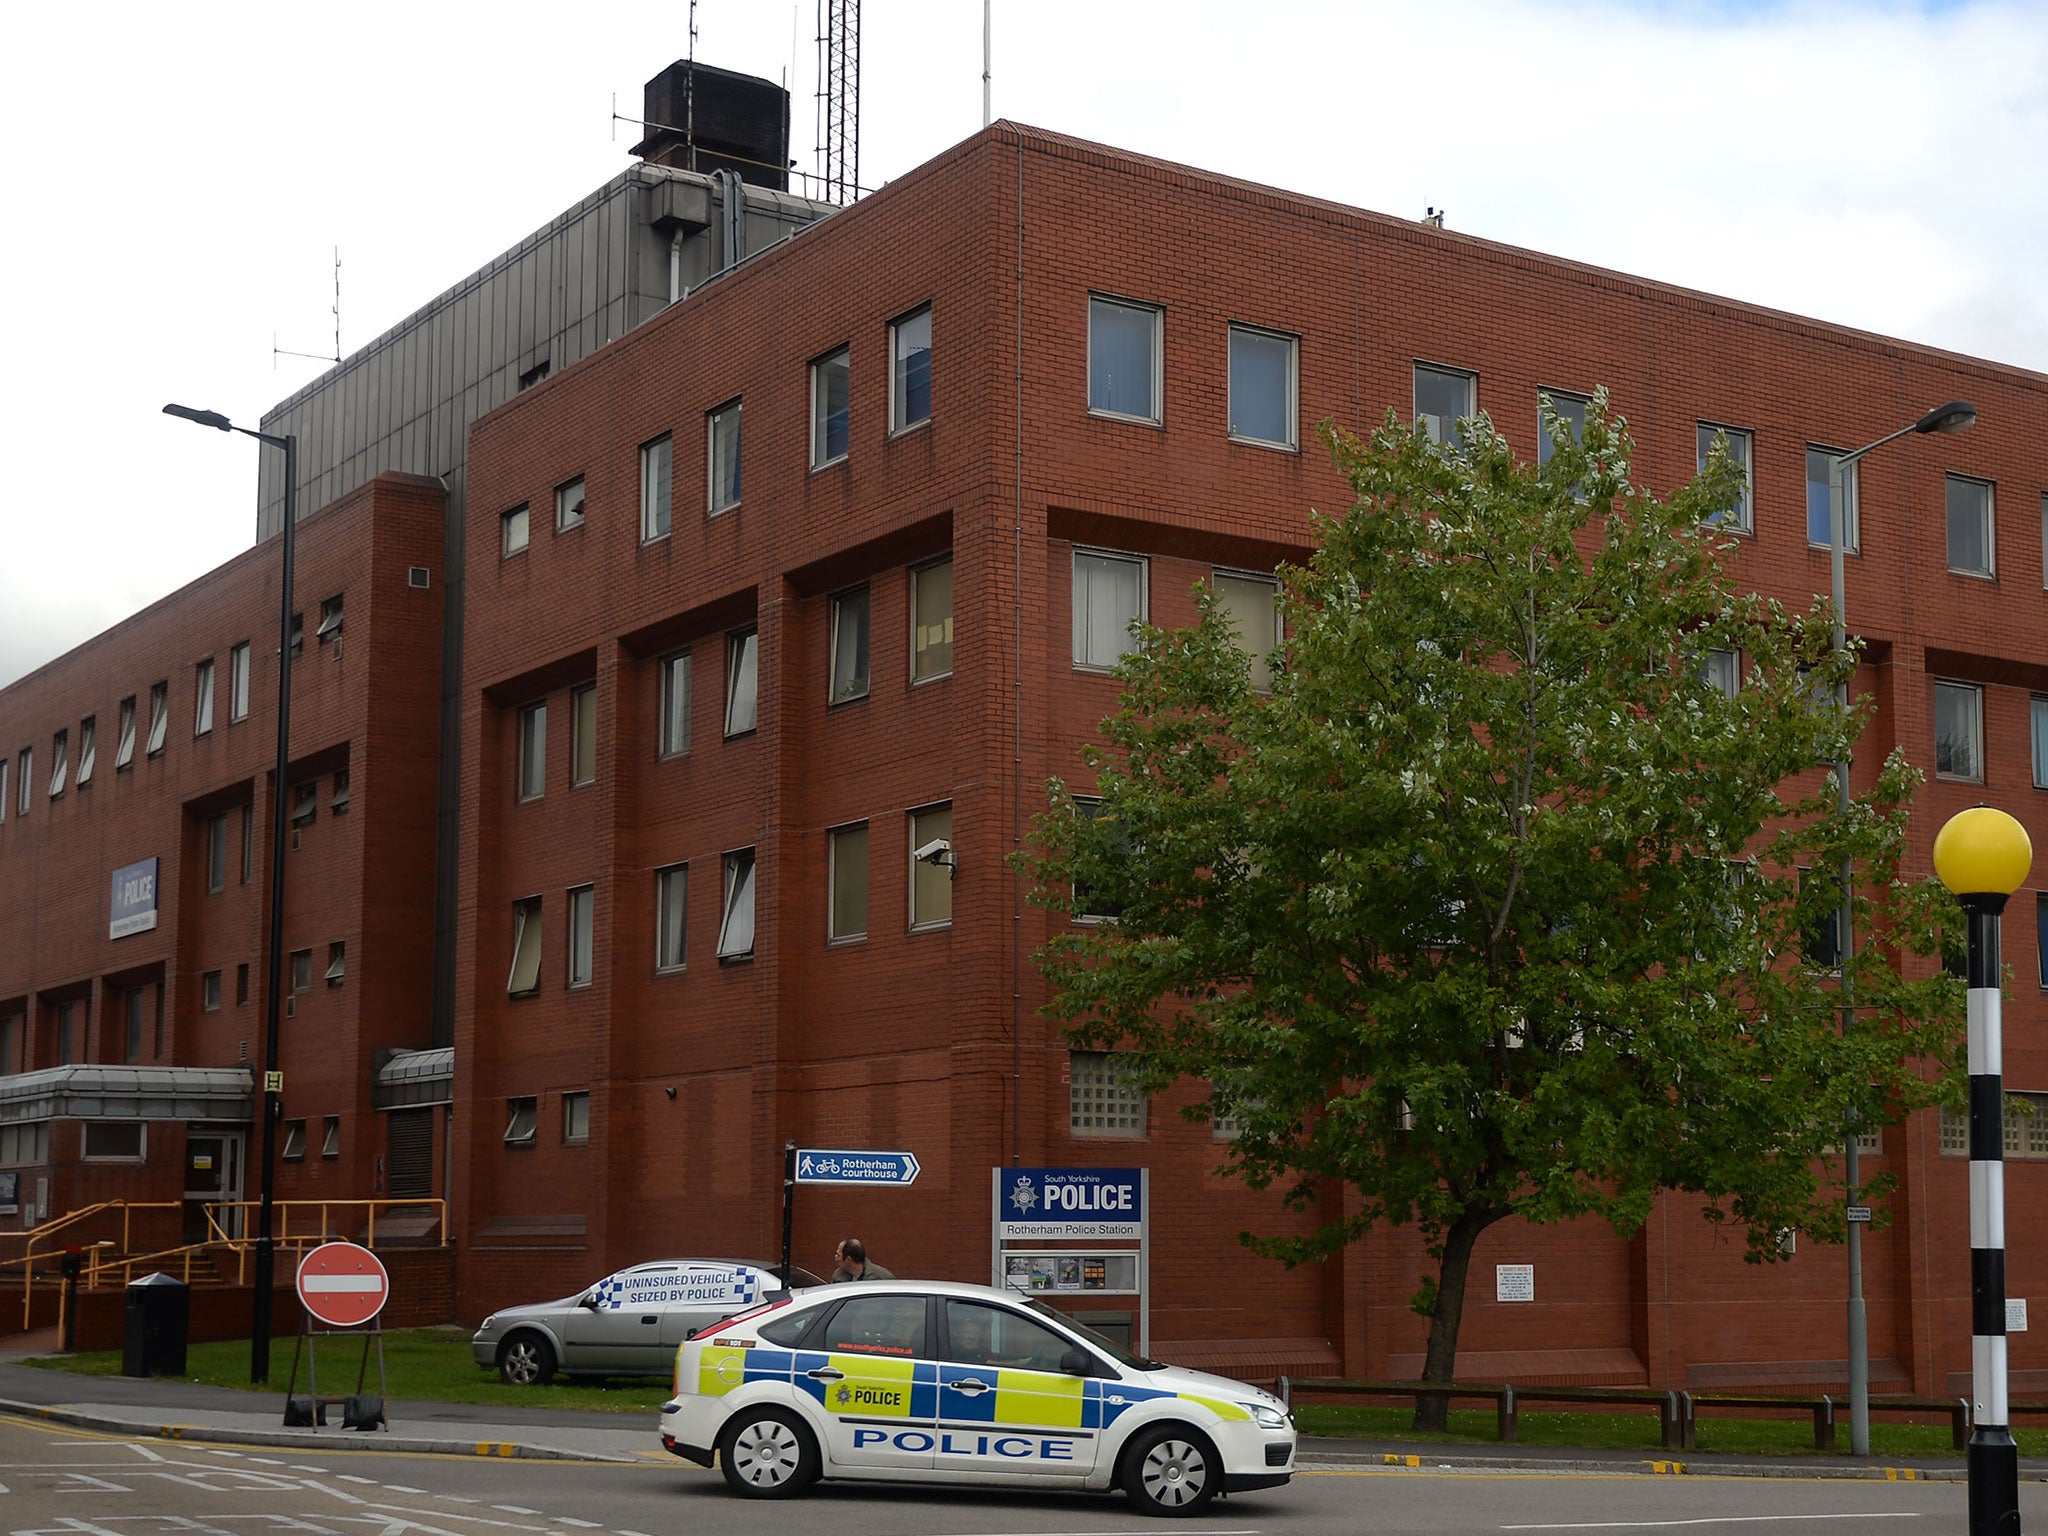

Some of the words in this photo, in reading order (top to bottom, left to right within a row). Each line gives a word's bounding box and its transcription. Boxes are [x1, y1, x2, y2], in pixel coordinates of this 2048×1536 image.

[124, 875, 152, 906] POLICE
[842, 1159, 897, 1170] Rotherham
[842, 1169, 898, 1179] courthouse
[1044, 1175, 1066, 1183] South
[1067, 1175, 1101, 1183] Yorkshire
[1044, 1185, 1133, 1210] POLICE
[1007, 1225, 1063, 1234] Rotherham
[1065, 1225, 1096, 1234] Police
[1098, 1225, 1134, 1234] Station
[624, 1275, 687, 1289] UNINSURED
[690, 1273, 735, 1285] VEHICLE
[630, 1290, 667, 1303] SEIZED
[670, 1289, 685, 1301] BY
[687, 1287, 726, 1300] POLICE
[855, 1390, 901, 1406] POLICE
[853, 1429, 1074, 1461] POLICE
